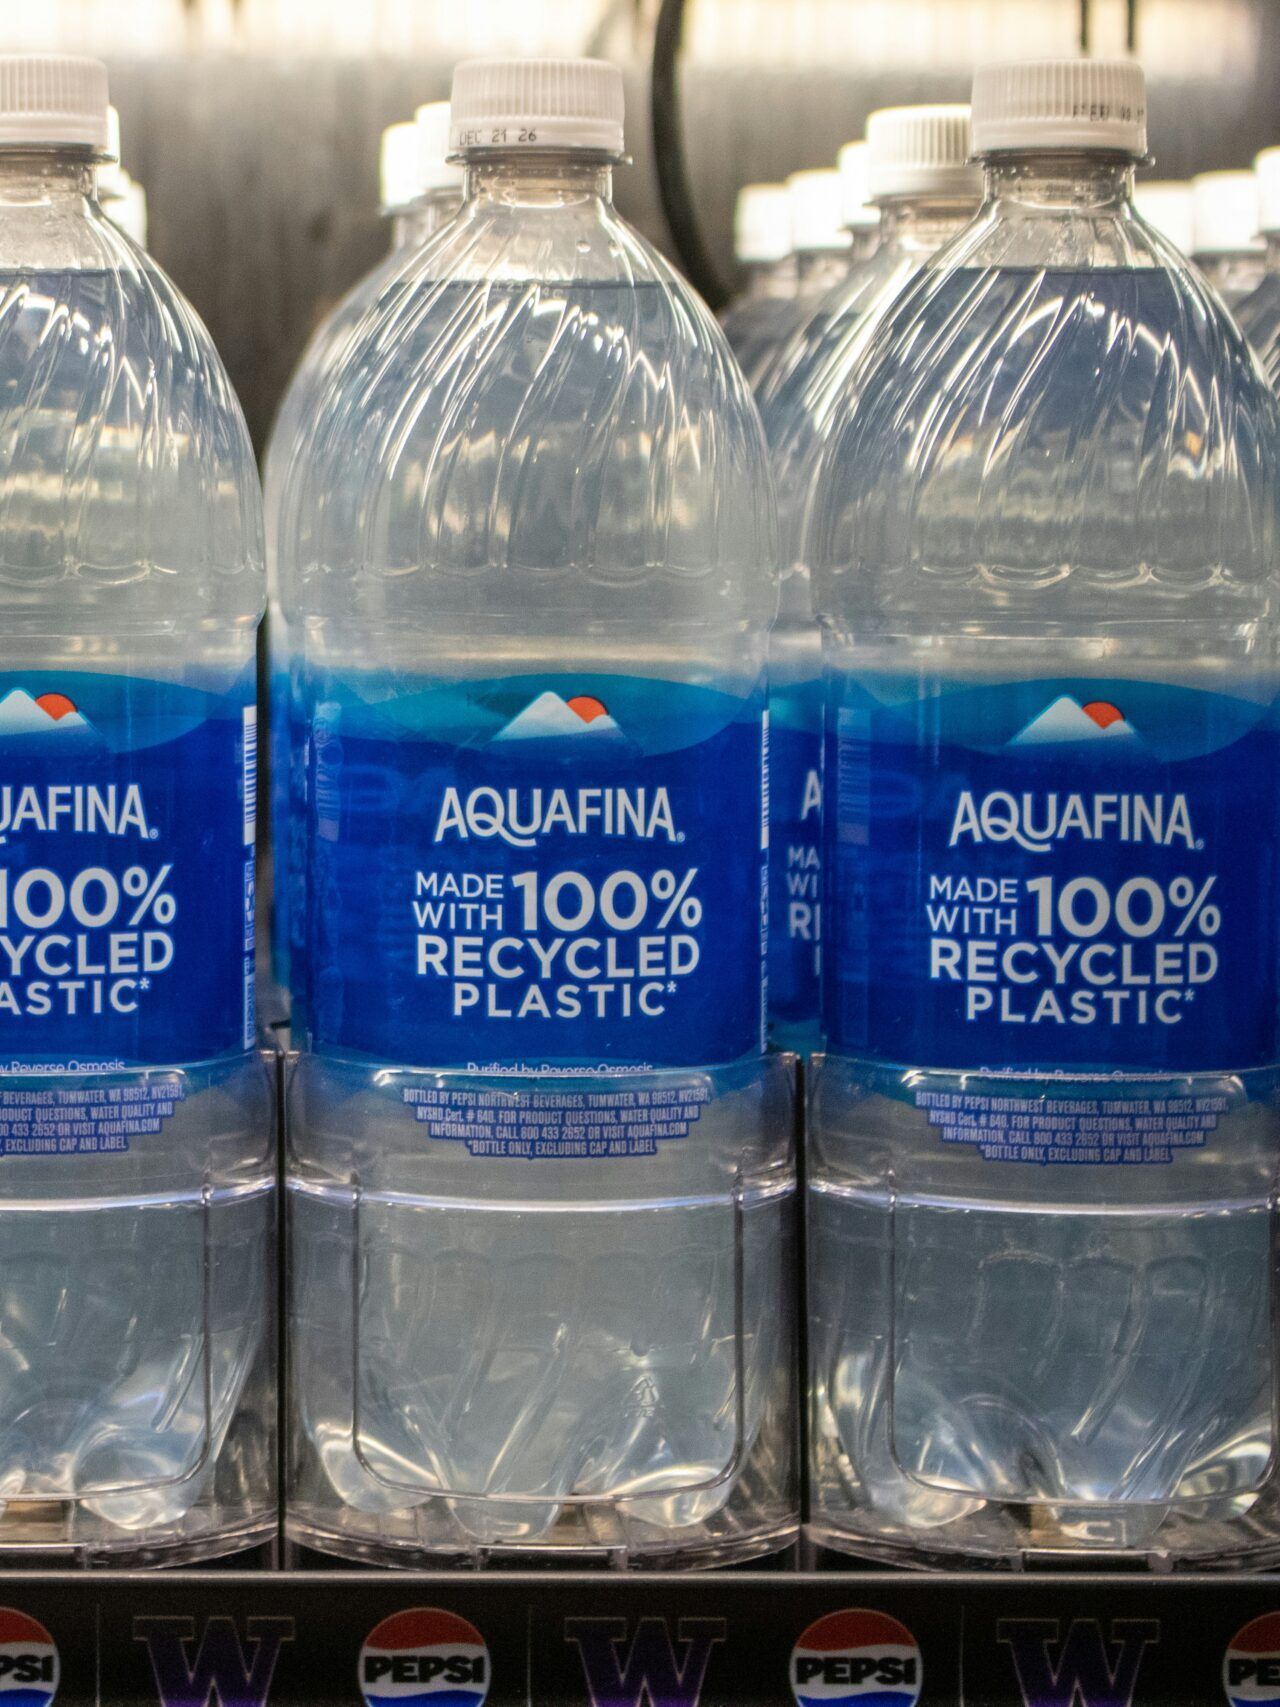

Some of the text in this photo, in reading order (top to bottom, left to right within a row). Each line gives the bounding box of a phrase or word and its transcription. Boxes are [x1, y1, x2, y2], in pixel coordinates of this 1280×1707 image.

[492, 128, 507, 143] 21
[518, 128, 537, 142] 26
[788, 846, 820, 869] MA
[417, 872, 503, 898] MADE
[786, 873, 818, 898] WI
[931, 876, 1018, 902] MADE
[512, 869, 702, 931] 100%
[1027, 877, 1220, 937] 100%
[413, 901, 502, 930] WITH
[927, 906, 1017, 934] WITH
[418, 935, 699, 978] RECYCLED
[931, 939, 1217, 984] RECYCLED
[132, 1616, 295, 1707] W
[365, 1656, 485, 1683] PEPSI
[564, 1617, 726, 1707] W
[796, 1657, 916, 1685] PEPSI
[997, 1618, 1160, 1707] W
